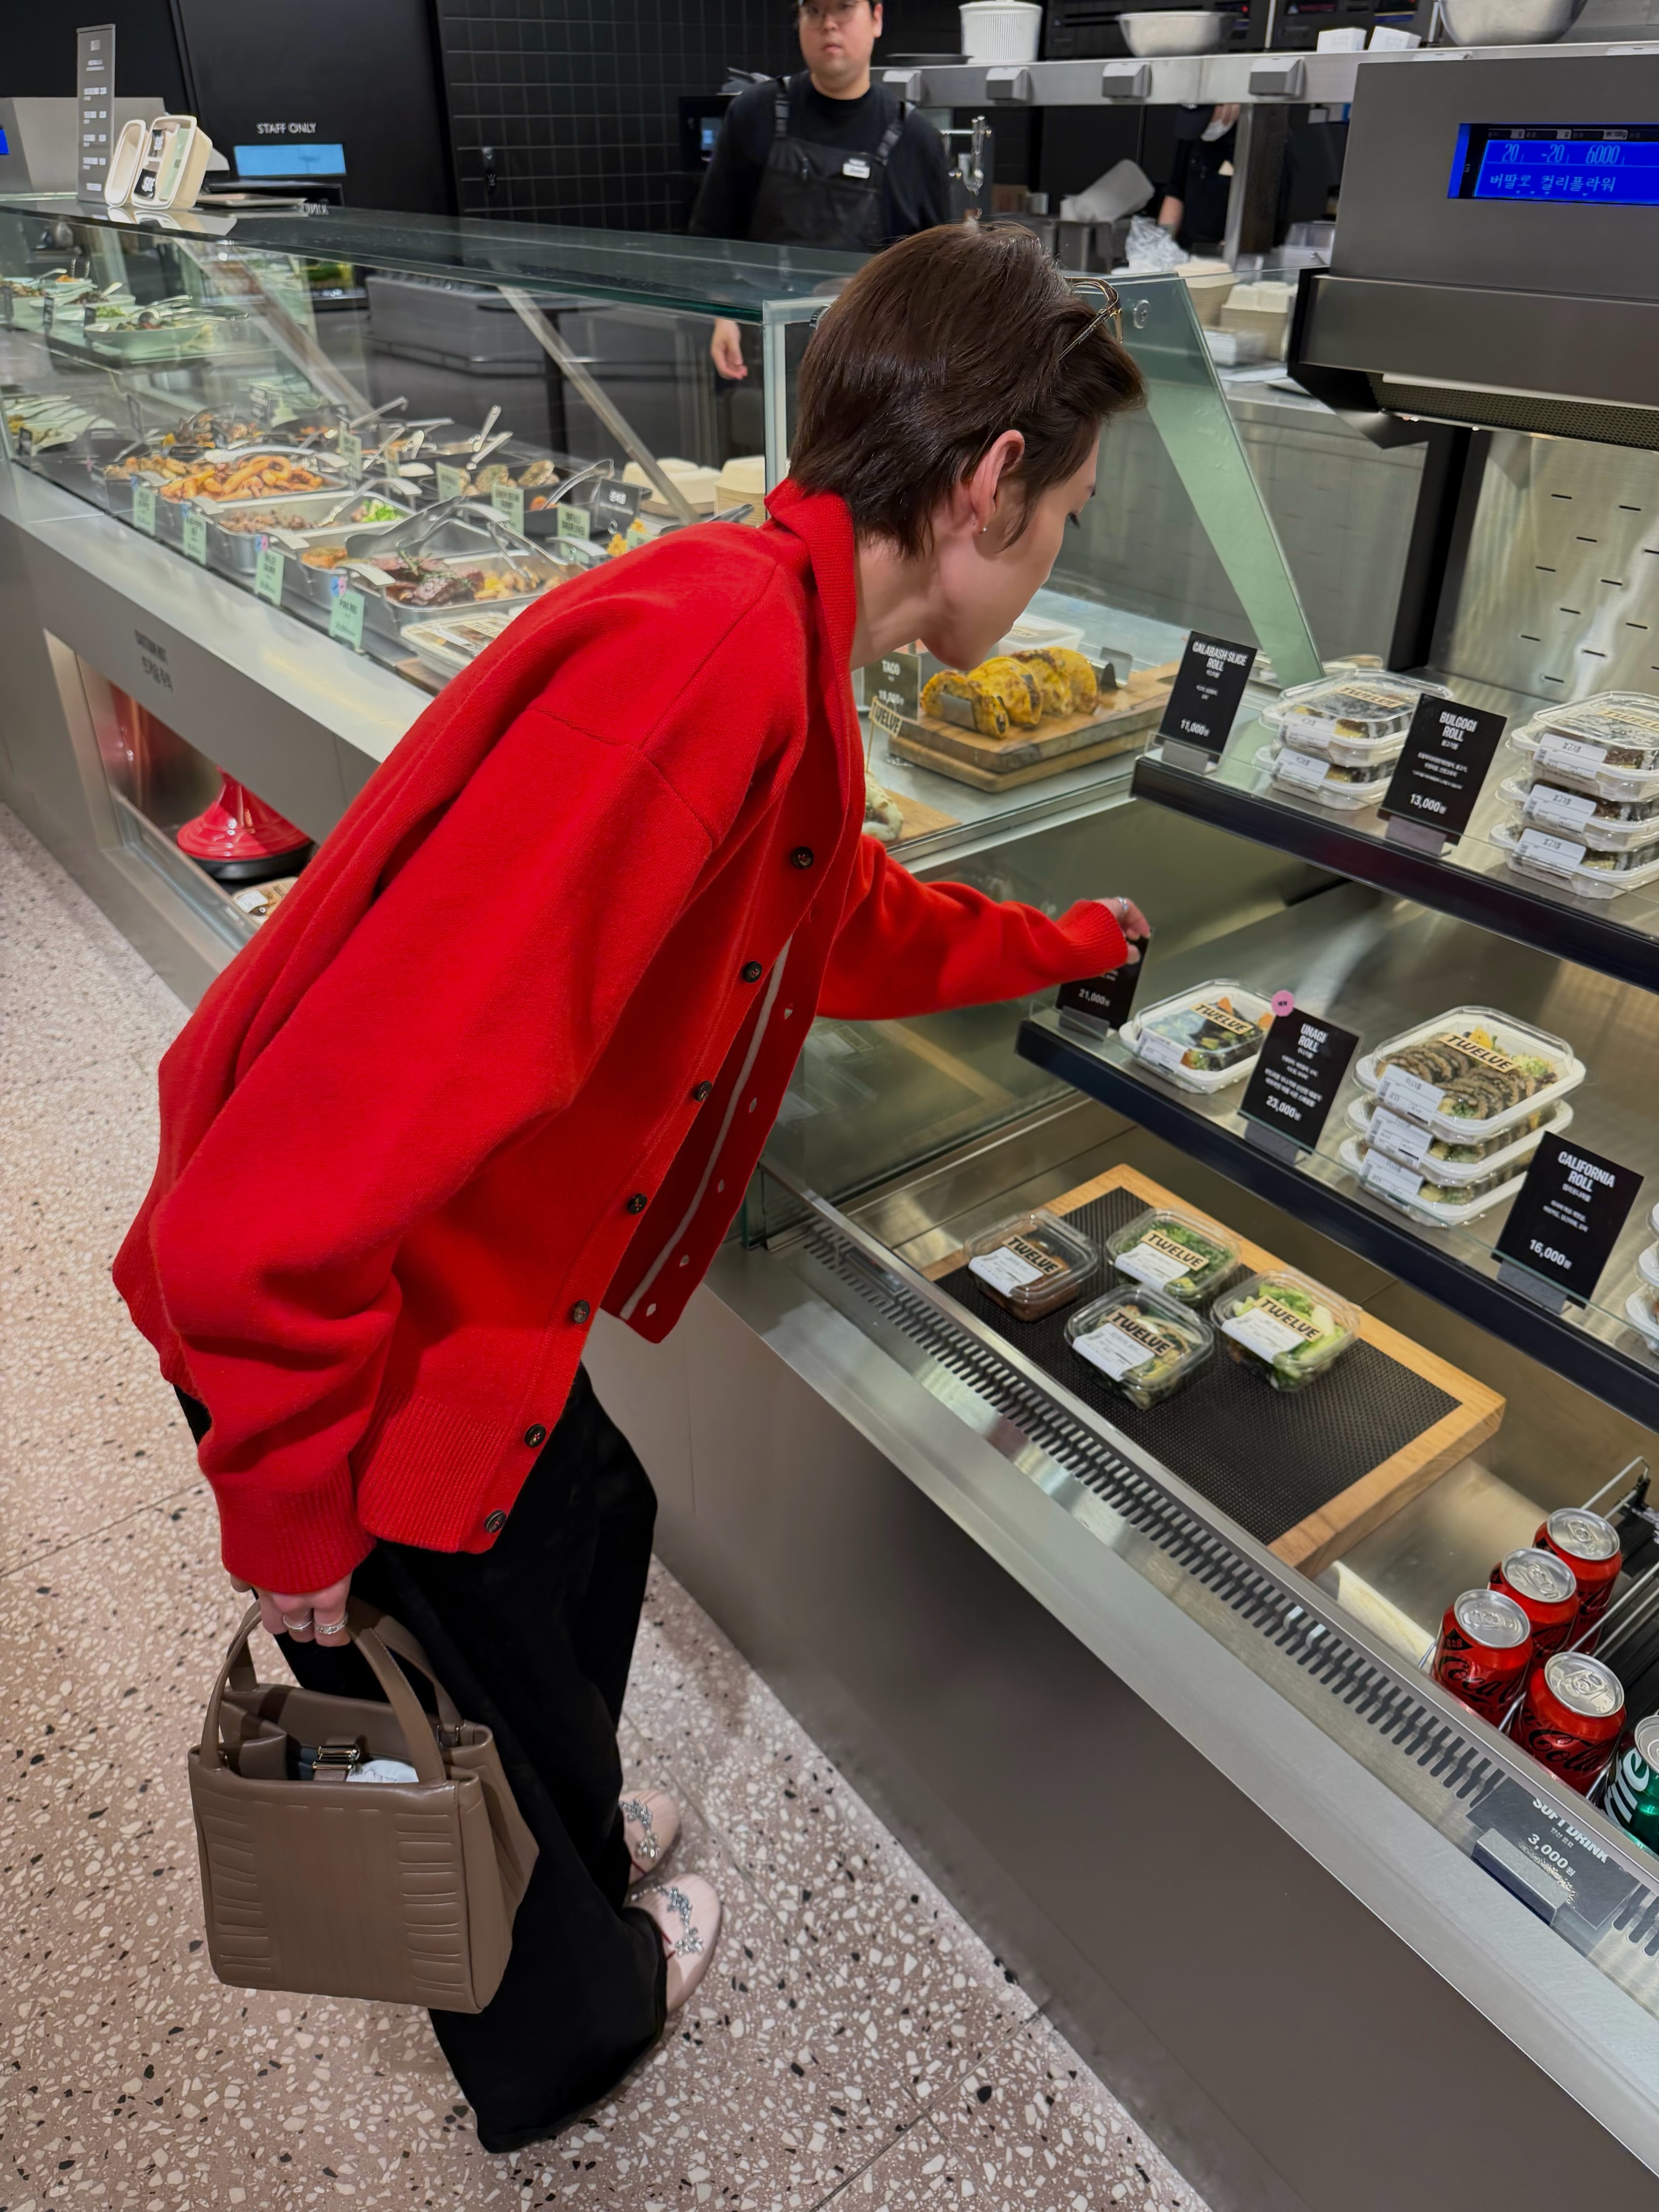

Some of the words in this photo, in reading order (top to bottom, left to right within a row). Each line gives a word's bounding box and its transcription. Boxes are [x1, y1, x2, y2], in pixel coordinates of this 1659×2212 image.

[257, 122, 286, 134] STAFF
[288, 122, 316, 133] ONLY
[1502, 144, 1520, 161] 20
[1541, 144, 1564, 163] -20
[1586, 145, 1620, 164] 6000
[1490, 173, 1532, 189] 버팔로
[1541, 175, 1616, 192] 컬리플라워
[1206, 657, 1225, 672] ROLL
[1439, 711, 1478, 733] BULGOGI
[1442, 726, 1464, 742] ROLL
[1410, 793, 1447, 815] 13,000원
[1195, 1004, 1249, 1032] TWELVE
[1298, 1035, 1319, 1053] ROLL
[1300, 1023, 1328, 1043] UNAGI
[1445, 1035, 1513, 1071] TWELVE
[1557, 1151, 1616, 1188] CALIFORNIA
[1568, 1171, 1593, 1192] ROLL
[1007, 1237, 1059, 1273] TWELVE
[1146, 1232, 1205, 1269] TWELVE
[1529, 1239, 1573, 1270] 16,000원
[1260, 1299, 1320, 1338] TWELVE
[1111, 1312, 1174, 1355] TWELVE
[1527, 1833, 1576, 1877] 3,000원
